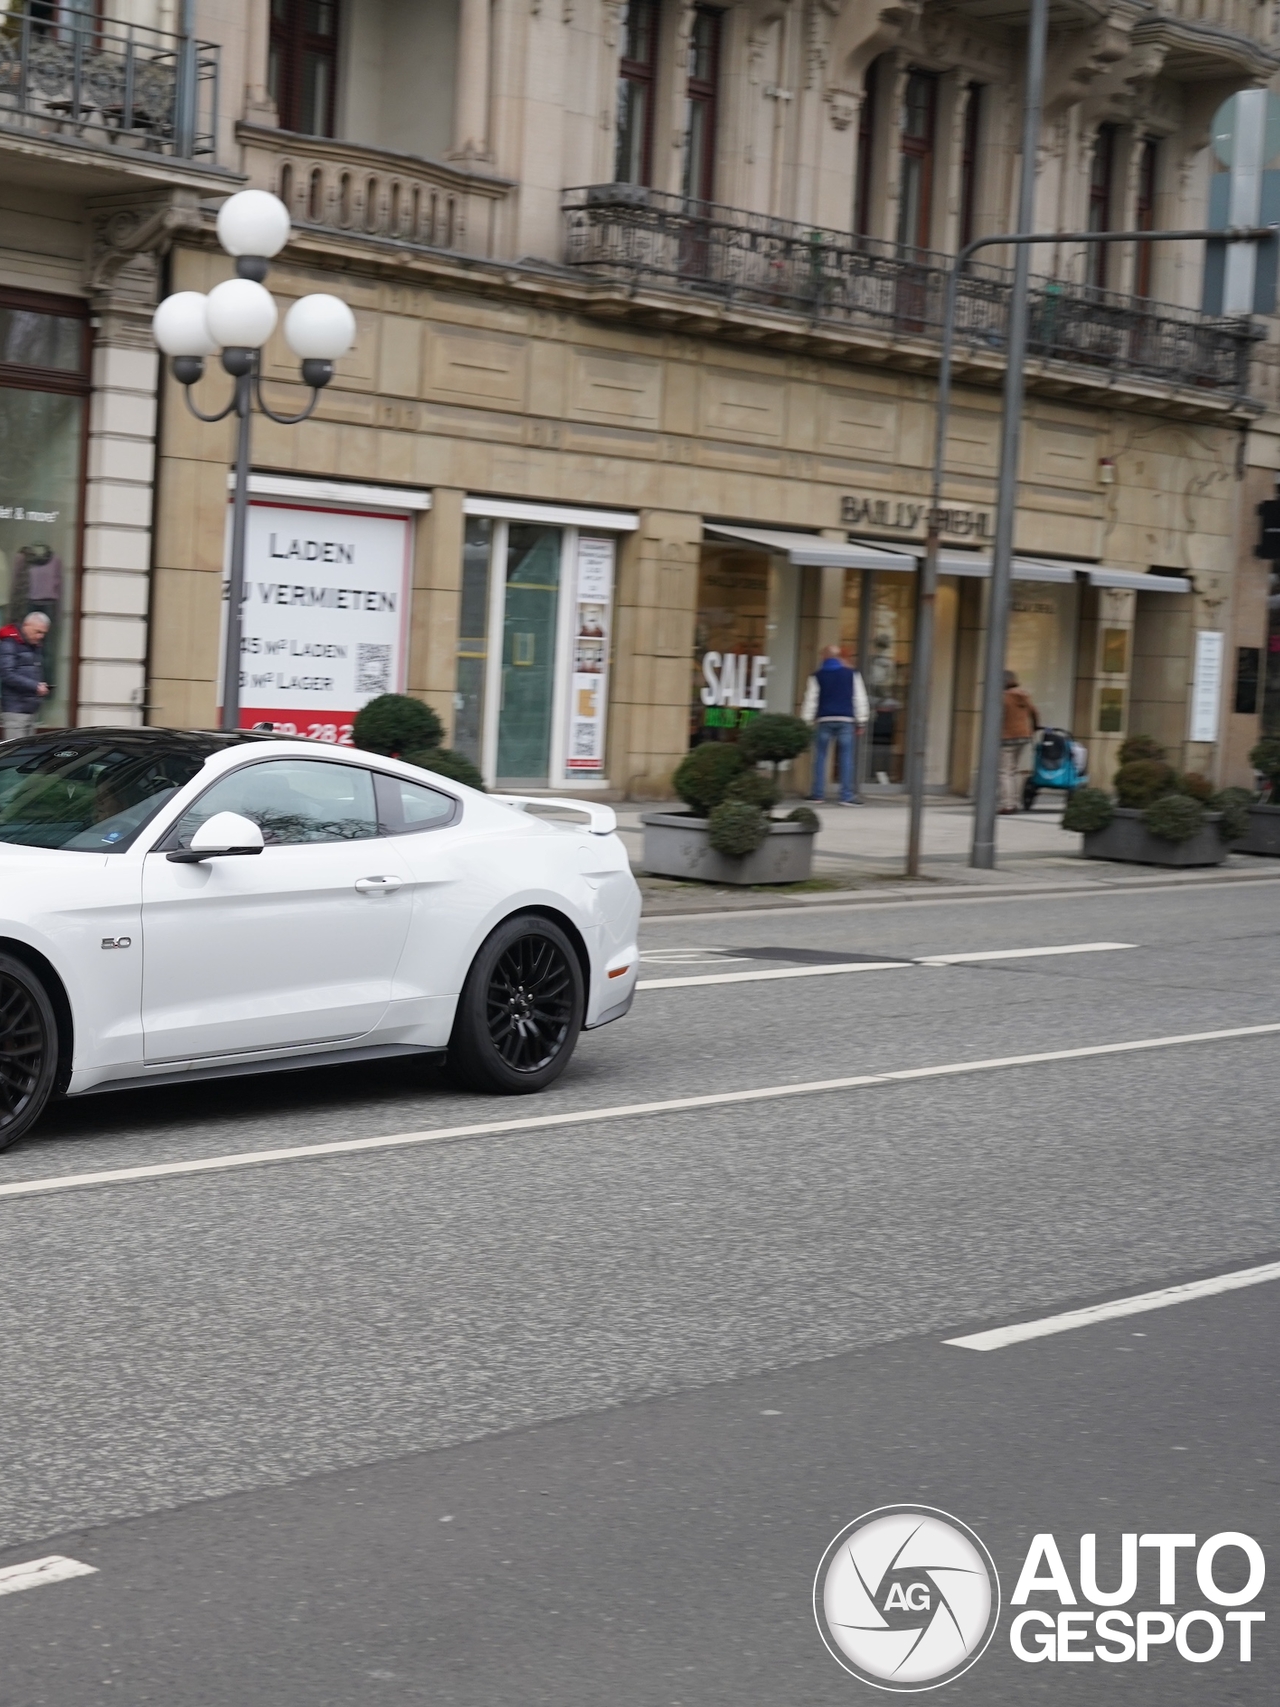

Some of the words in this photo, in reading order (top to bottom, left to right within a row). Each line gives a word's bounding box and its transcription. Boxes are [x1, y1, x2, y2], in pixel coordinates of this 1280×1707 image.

[268, 532, 356, 564] LADEN
[257, 582, 398, 613] VERMIETEN
[289, 639, 349, 659] LADEN
[700, 651, 769, 709] SALE
[100, 936, 132, 950] 5.0
